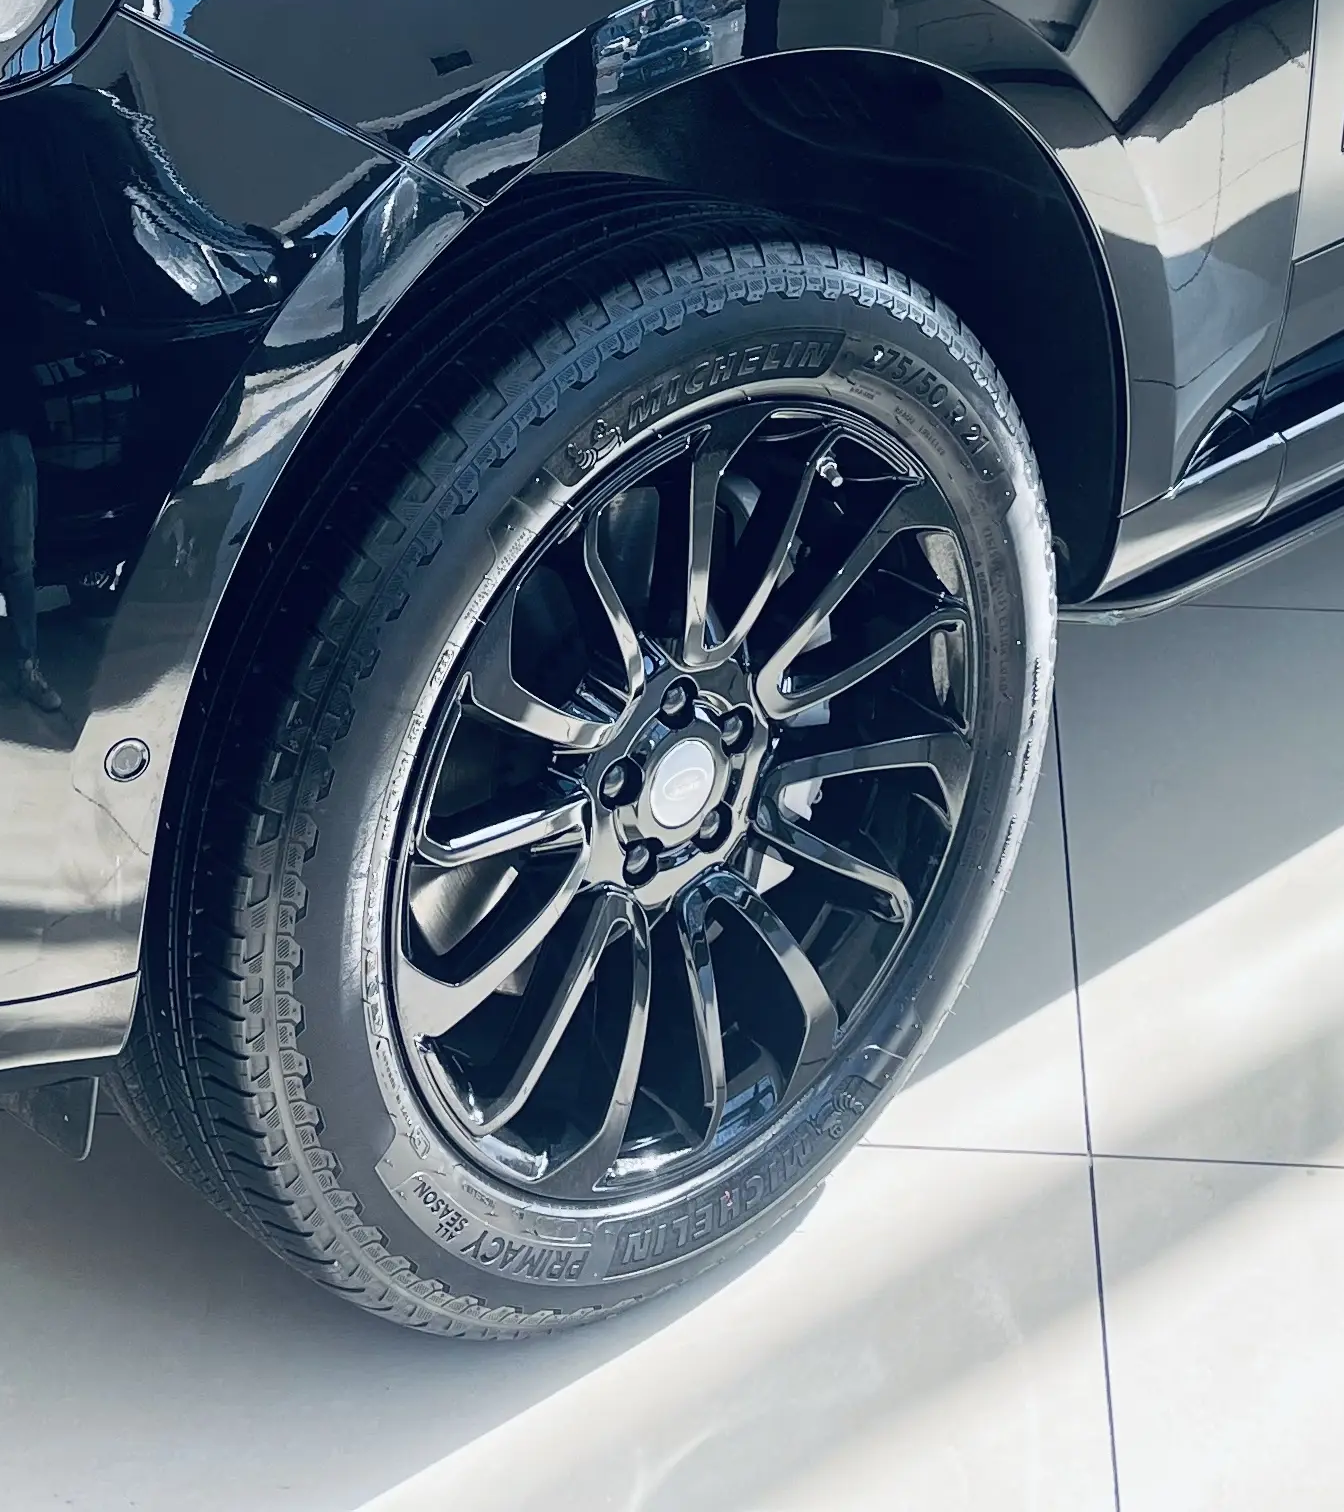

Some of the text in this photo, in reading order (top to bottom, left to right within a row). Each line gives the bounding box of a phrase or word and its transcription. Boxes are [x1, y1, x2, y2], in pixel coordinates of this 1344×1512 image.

[627, 341, 832, 431] MICHELIN
[863, 345, 949, 409] 275/50
[413, 1180, 469, 1234] SEASON
[622, 1122, 818, 1265] MICHELIN
[434, 1222, 457, 1243] ALL
[459, 1229, 589, 1282] PRIMACY
